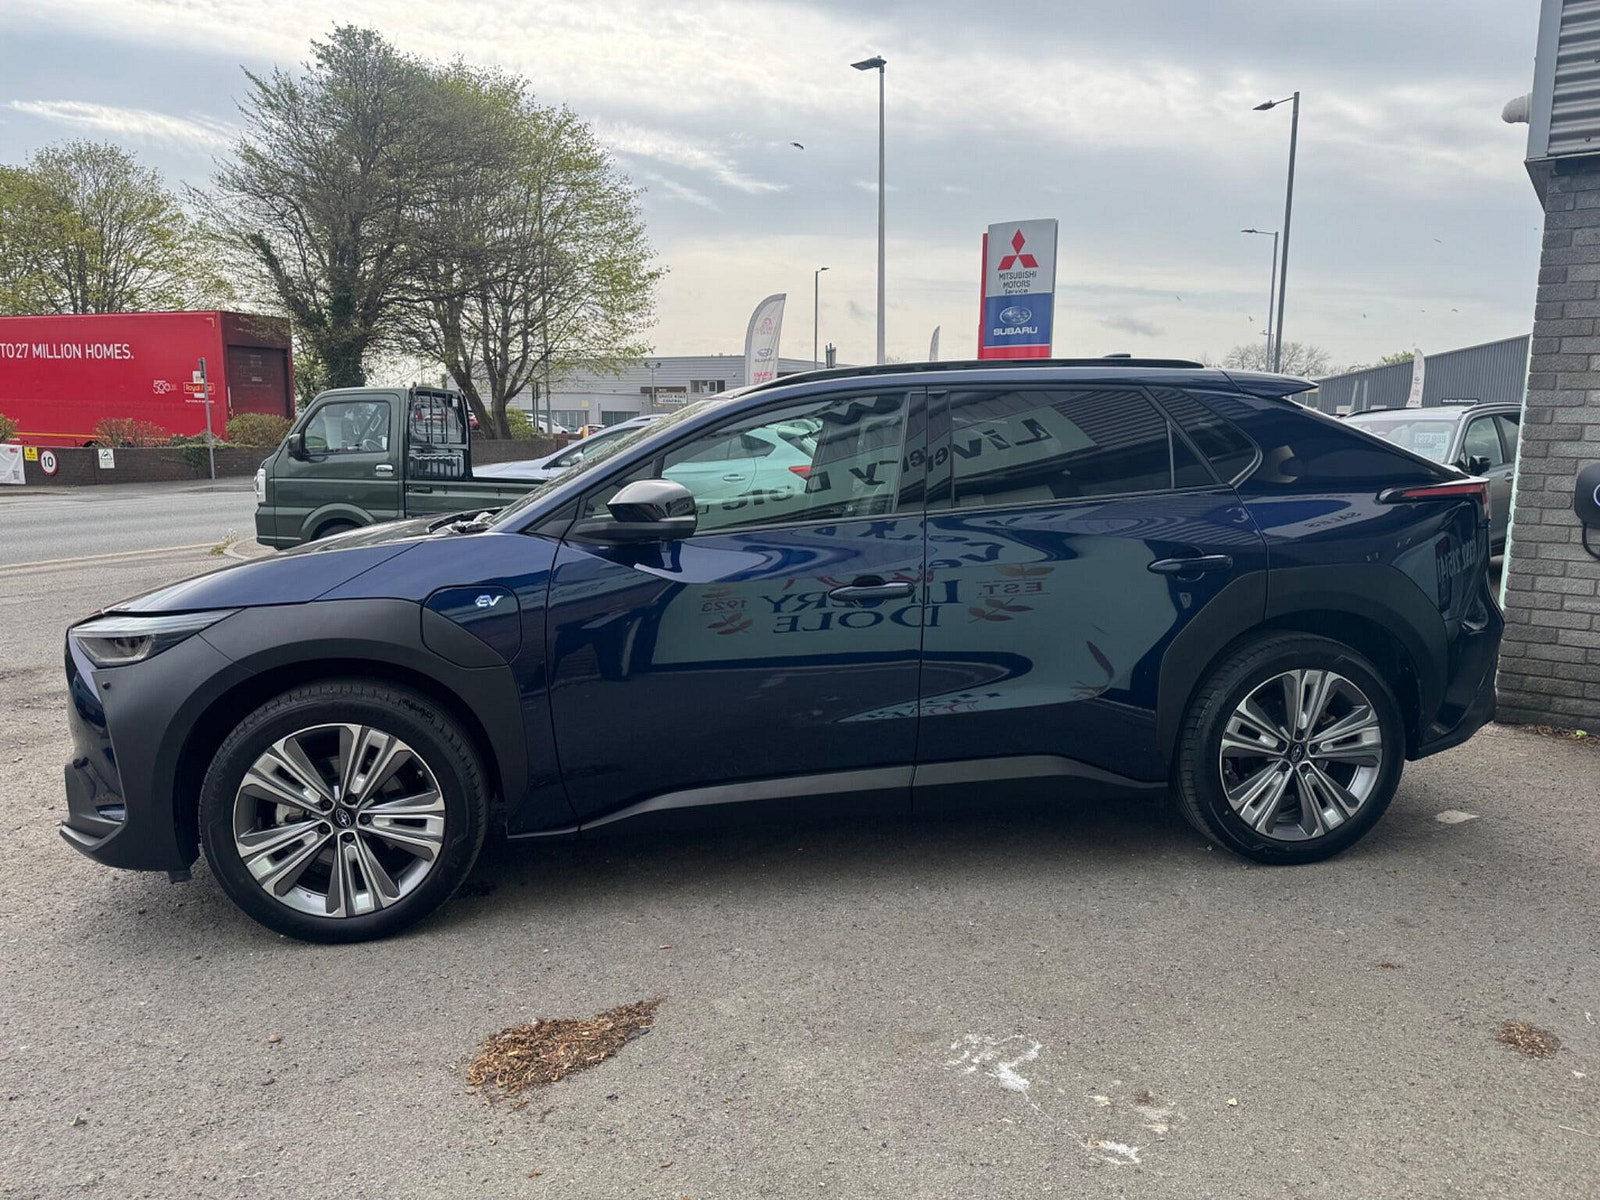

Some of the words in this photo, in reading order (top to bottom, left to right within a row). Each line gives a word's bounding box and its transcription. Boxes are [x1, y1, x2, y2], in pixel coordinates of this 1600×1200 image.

[998, 271, 1038, 281] MITSUBISHI
[1003, 280, 1031, 289] MOTORS
[993, 326, 1038, 336] SUBARU
[0, 343, 15, 358] TO
[16, 343, 29, 358] 27
[32, 343, 82, 359] MILLION
[86, 343, 134, 359] HOMES.
[43, 456, 54, 468] 10
[474, 594, 504, 607] EV
